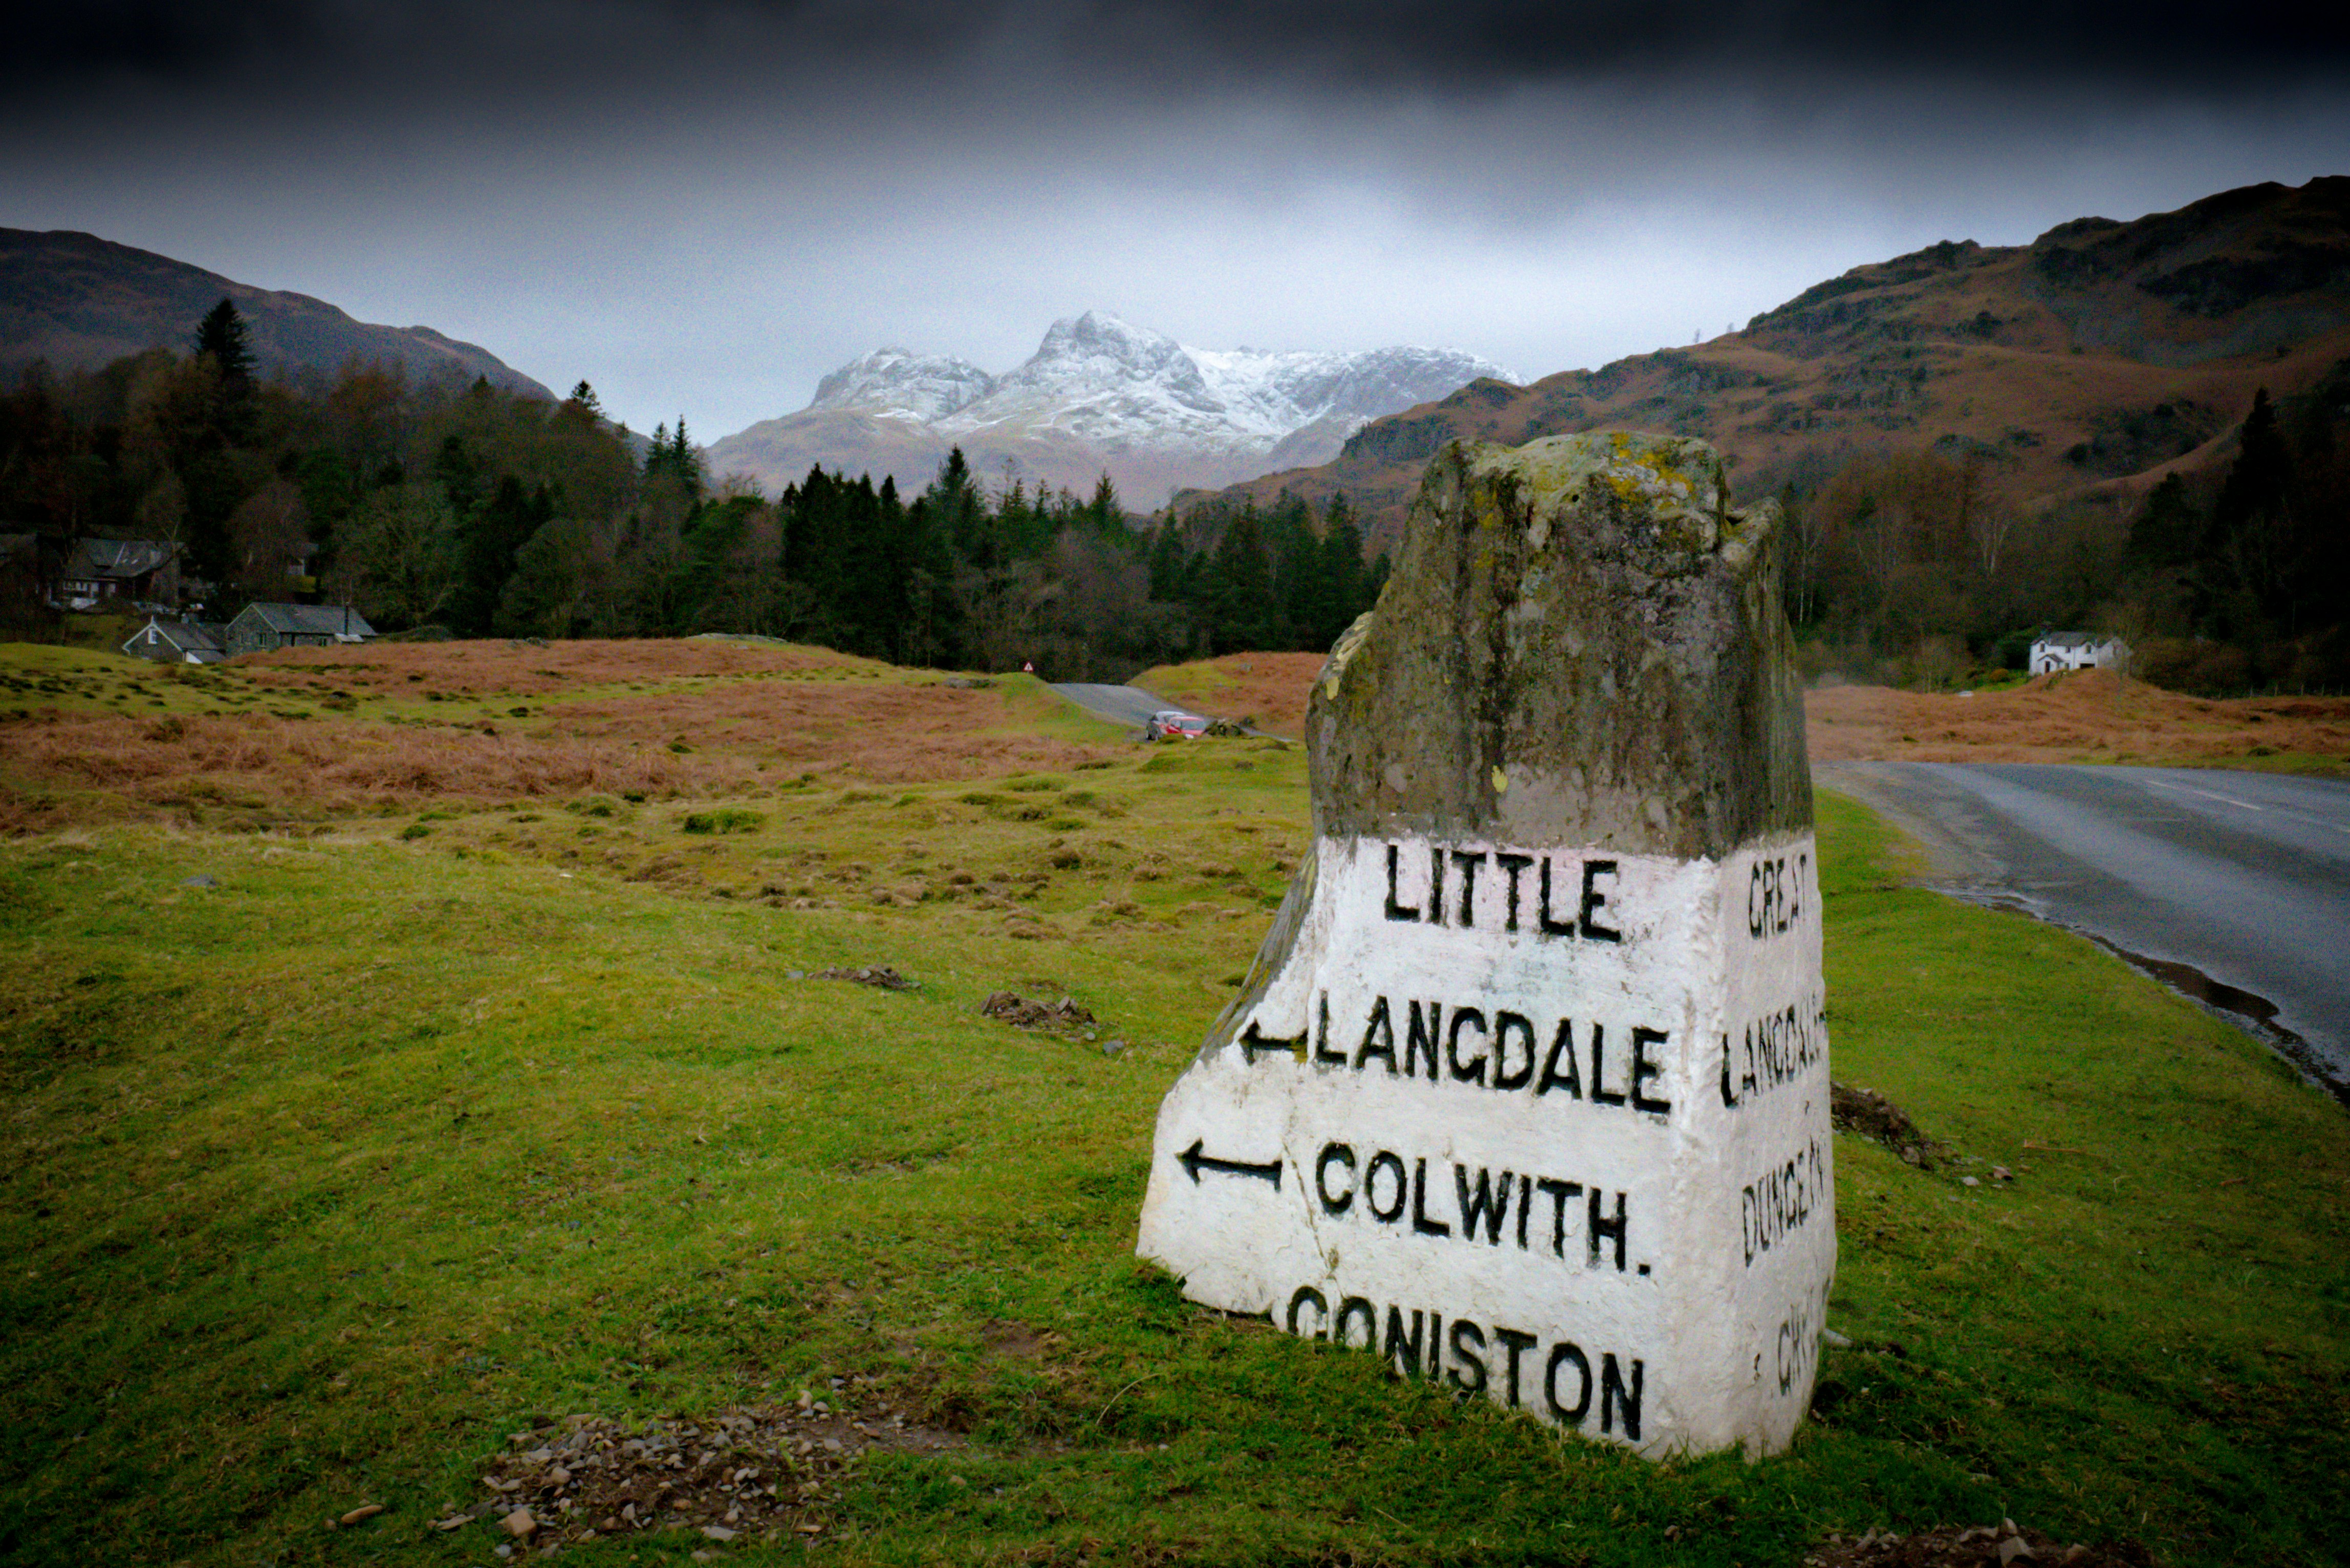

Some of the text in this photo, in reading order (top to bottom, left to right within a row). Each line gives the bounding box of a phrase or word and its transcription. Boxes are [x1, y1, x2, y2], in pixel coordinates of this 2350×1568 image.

[1384, 844, 1622, 943] LITTLE
[1748, 854, 1808, 941] GREAT
[1314, 989, 1671, 1115] LANGDALE
[1315, 1141, 1651, 1275] COLWITH.
[1287, 1285, 1644, 1442] CONISTON
